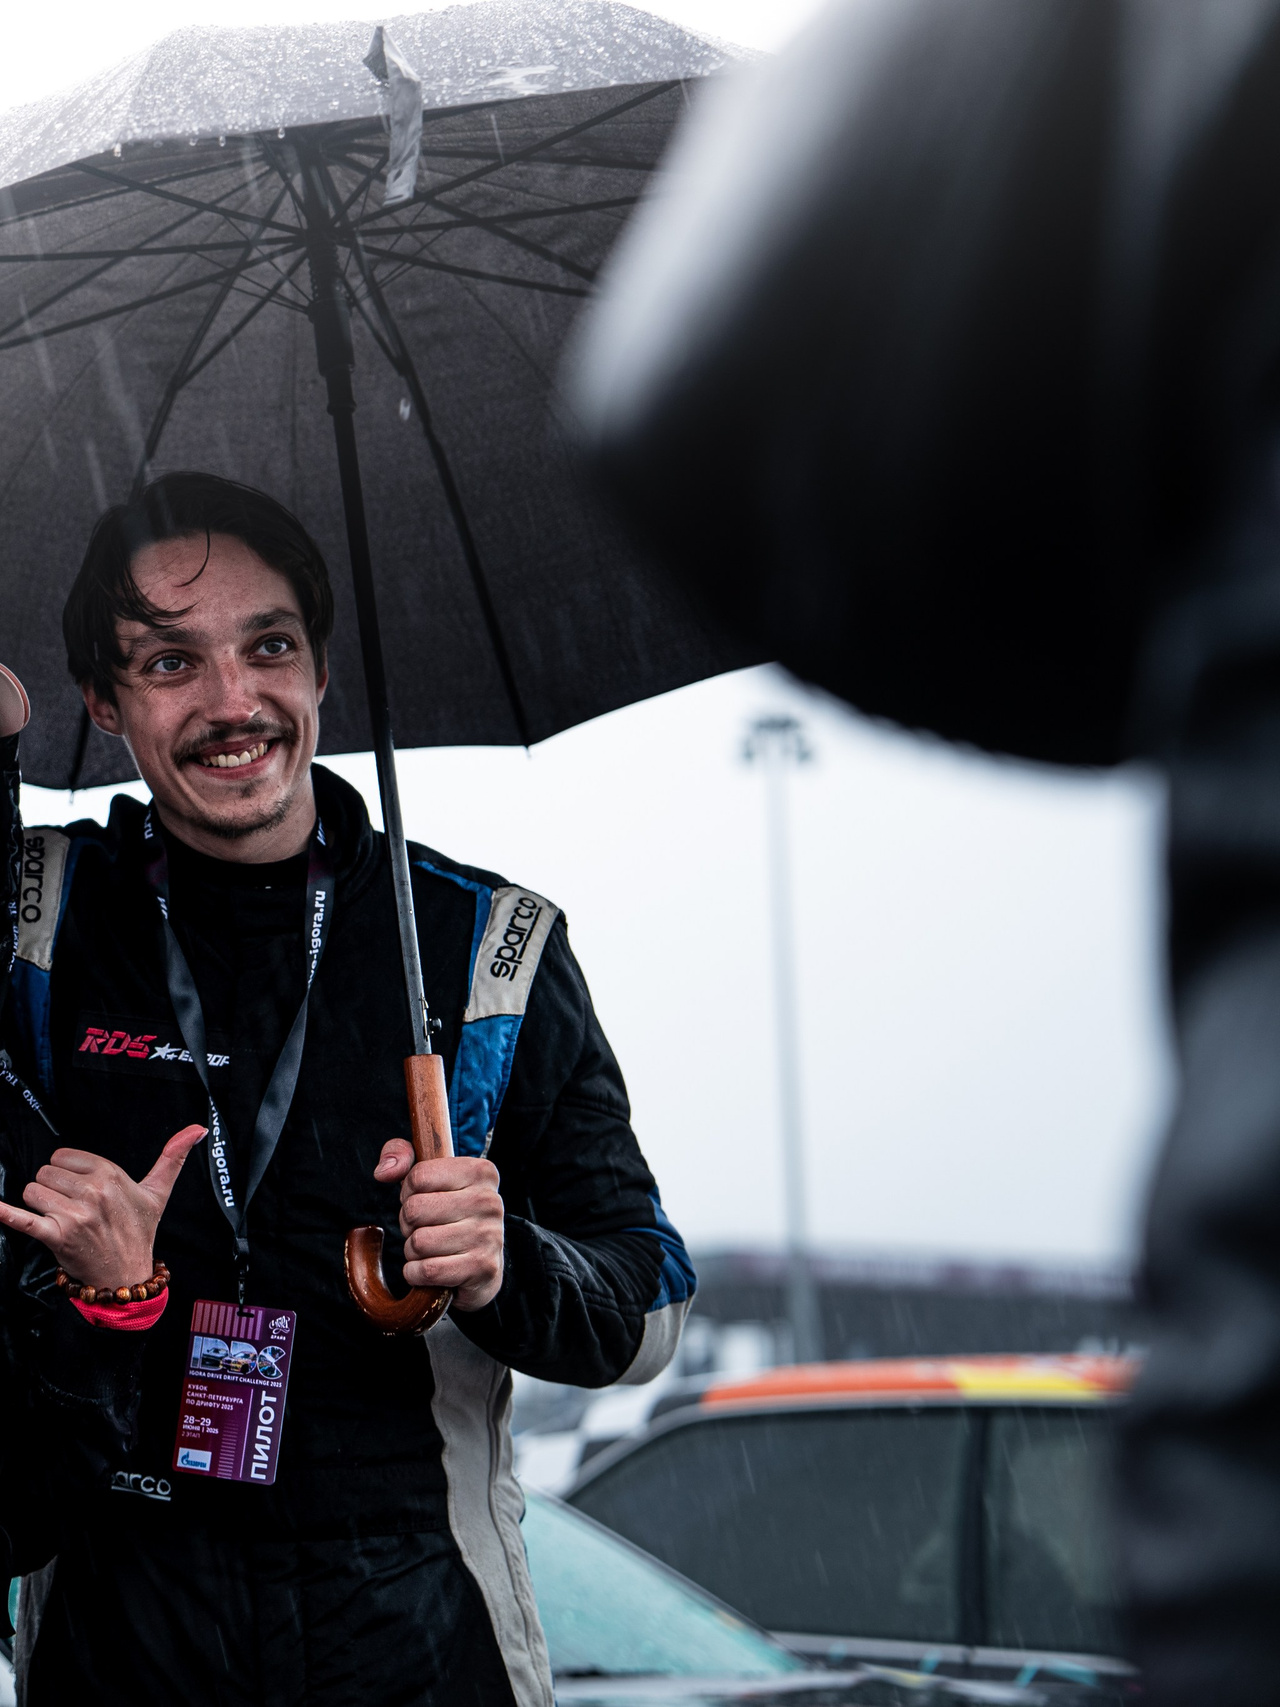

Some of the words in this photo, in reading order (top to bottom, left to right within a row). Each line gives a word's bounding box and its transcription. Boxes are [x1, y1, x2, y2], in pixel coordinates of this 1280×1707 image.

[21, 836, 45, 923] sparco
[490, 897, 538, 979] sparco
[78, 1027, 158, 1060] RDS
[189, 1370, 206, 1378] IGORA
[206, 1371, 223, 1380] DRIVE
[223, 1373, 239, 1382] DRIFT
[239, 1376, 269, 1387] CHALLENGE
[187, 1391, 244, 1404] САНКТ-ПЕТЕРБУРГА
[195, 1399, 221, 1409] ДРИФТУ
[221, 1403, 234, 1411] 2025
[206, 1427, 219, 1435] 2025
[250, 1390, 277, 1480] ПИЛОТ
